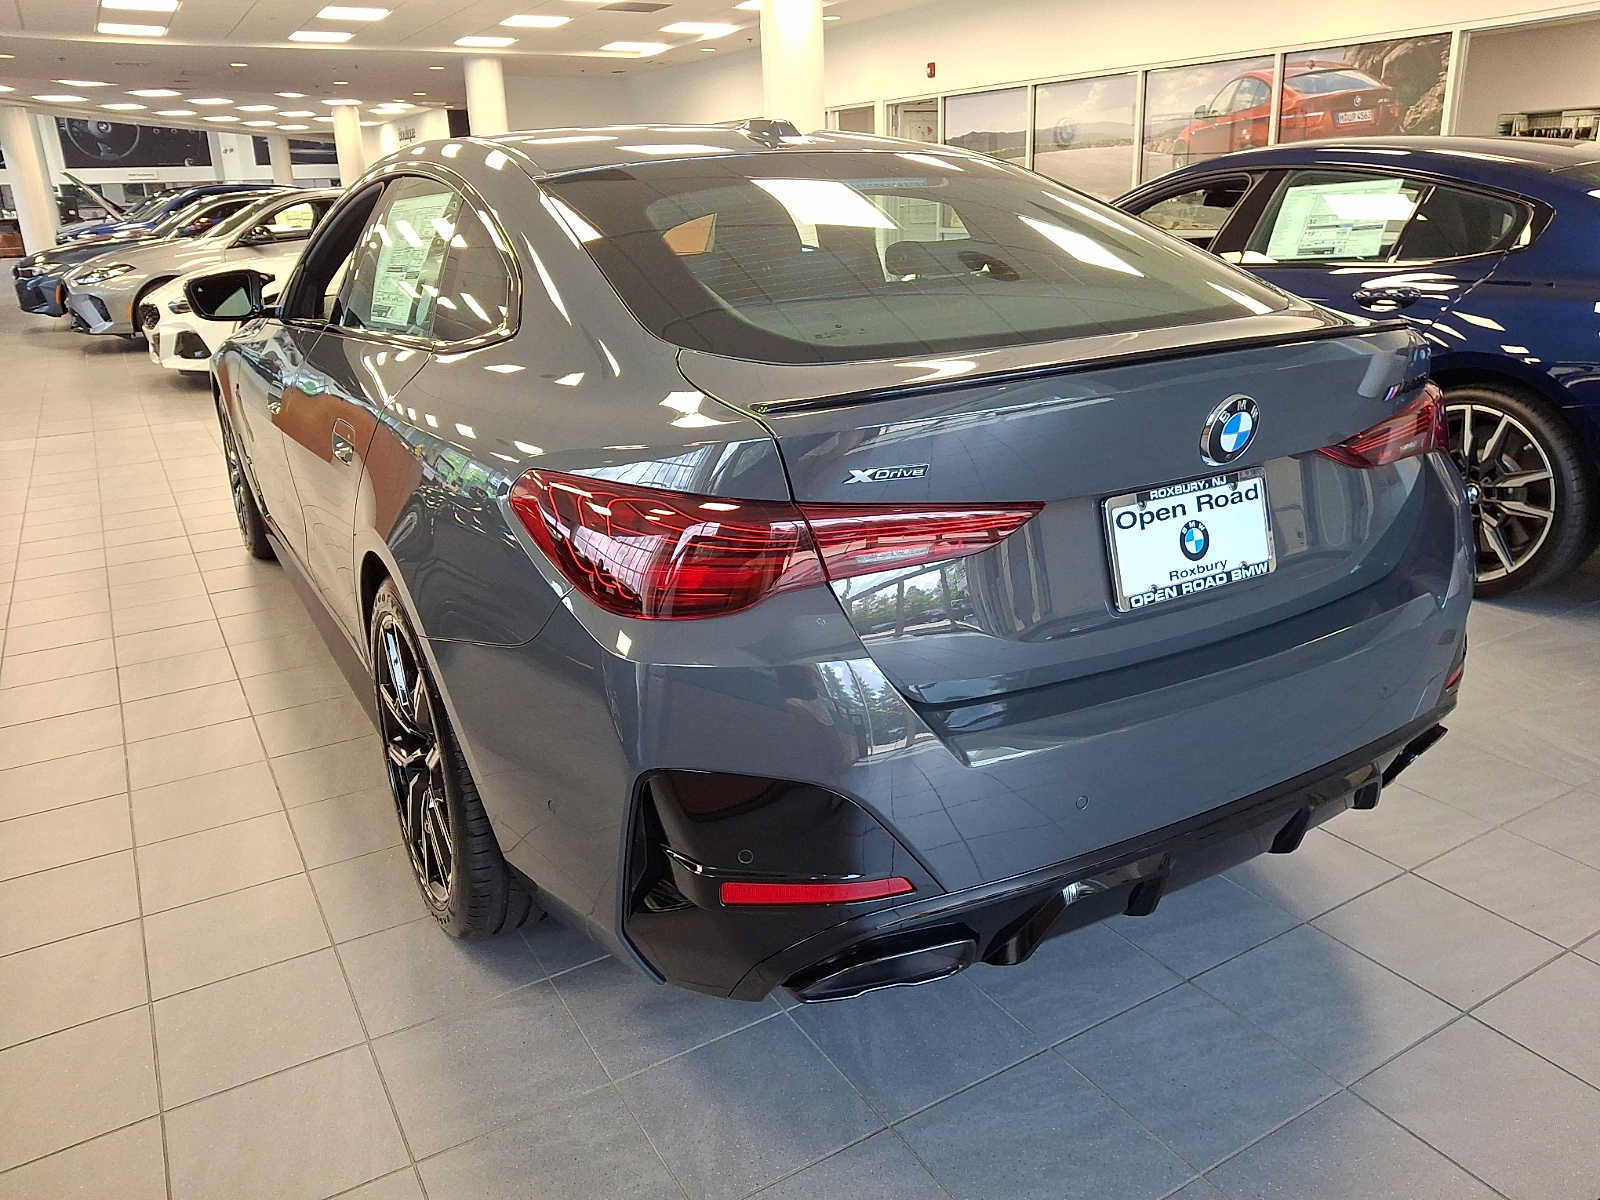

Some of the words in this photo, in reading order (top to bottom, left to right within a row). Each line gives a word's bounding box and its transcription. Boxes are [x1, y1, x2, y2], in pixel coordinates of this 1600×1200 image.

[1219, 399, 1259, 424] BMW
[1211, 476, 1227, 488] NJ
[1115, 503, 1187, 530] Open
[1196, 483, 1259, 512] Road
[1181, 520, 1206, 535] BMW
[1169, 560, 1228, 581] Roxbury
[1130, 586, 1177, 608] OPEN
[1182, 573, 1227, 595] ROAD
[1231, 562, 1269, 580] BMW
